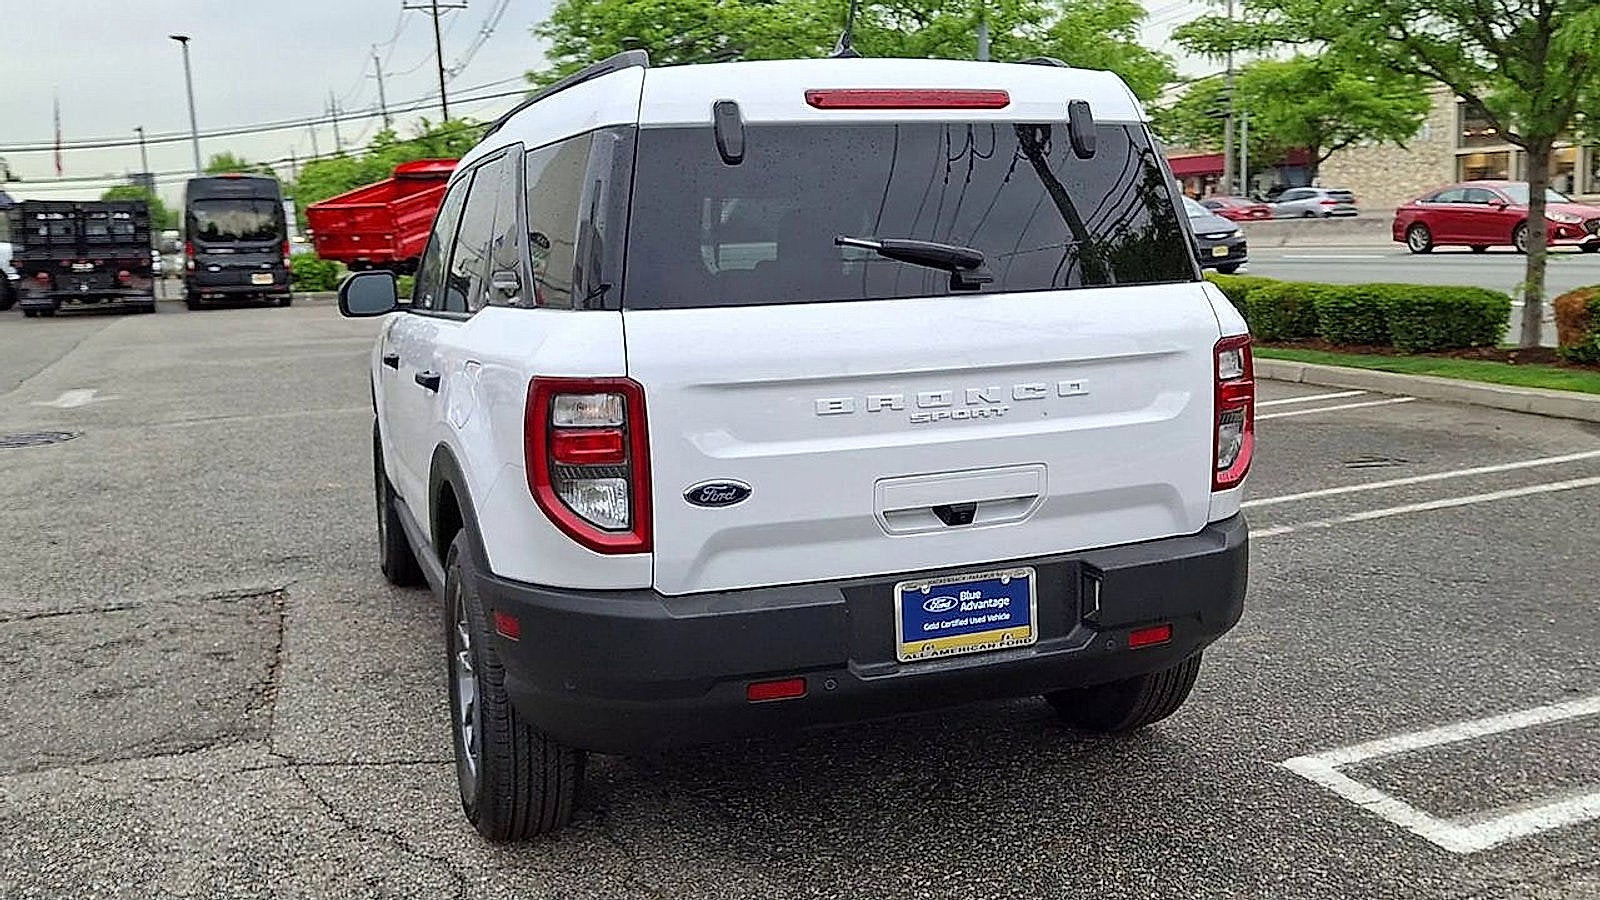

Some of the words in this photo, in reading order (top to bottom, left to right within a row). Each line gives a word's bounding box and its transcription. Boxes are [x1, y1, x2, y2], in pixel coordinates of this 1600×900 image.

[816, 378, 1089, 415] BRONCO
[910, 406, 1009, 423] SPORT
[699, 485, 737, 502] Ford
[960, 590, 982, 601] Blue
[960, 597, 1011, 612] Advantage
[923, 622, 940, 631] Gold
[940, 618, 969, 628] Certified
[969, 615, 987, 625] Used
[987, 612, 1011, 623] Vehicle
[902, 652, 925, 661] ALL
[930, 643, 996, 658] AMERICAN
[999, 637, 1033, 649] FORD
